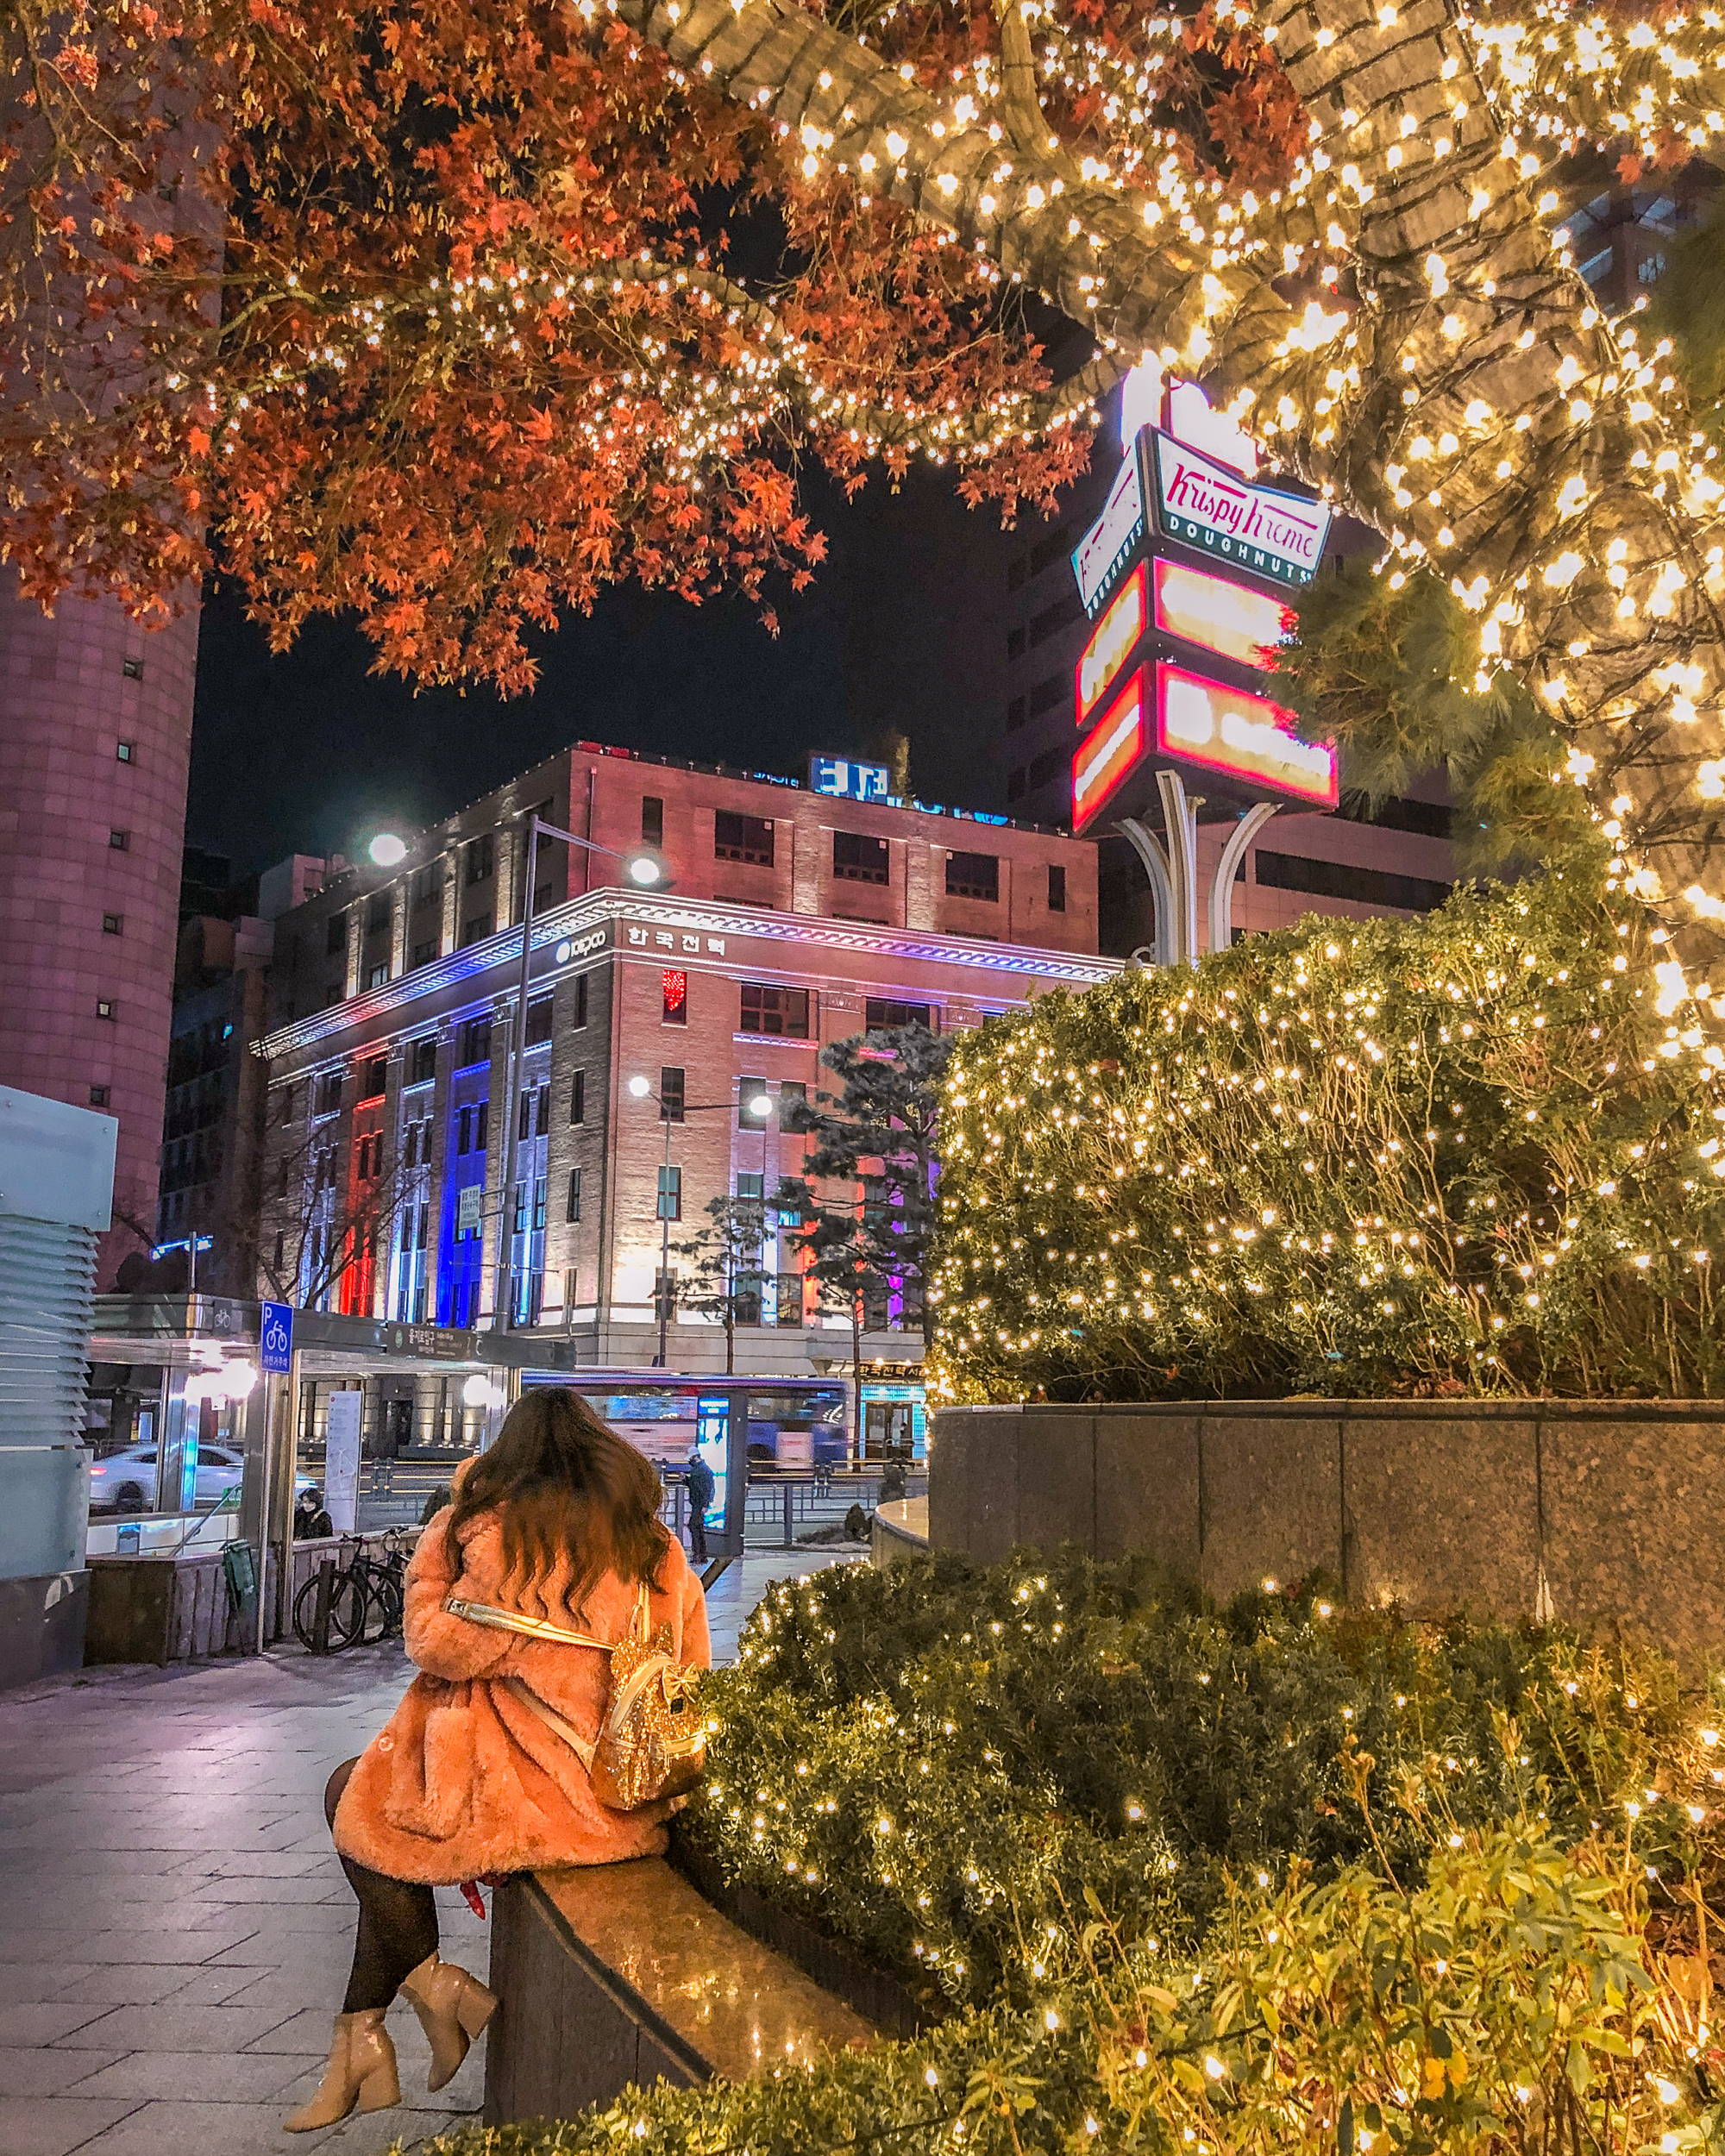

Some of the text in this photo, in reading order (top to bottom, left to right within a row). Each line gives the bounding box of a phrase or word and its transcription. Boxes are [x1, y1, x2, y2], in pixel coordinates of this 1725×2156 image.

[1166, 463, 1247, 535] Krispy
[1169, 517, 1308, 584] DOUGHNUTS
[628, 926, 725, 956] 한국전력
[264, 1306, 273, 1325] P
[408, 1328, 436, 1346] 을지로입구
